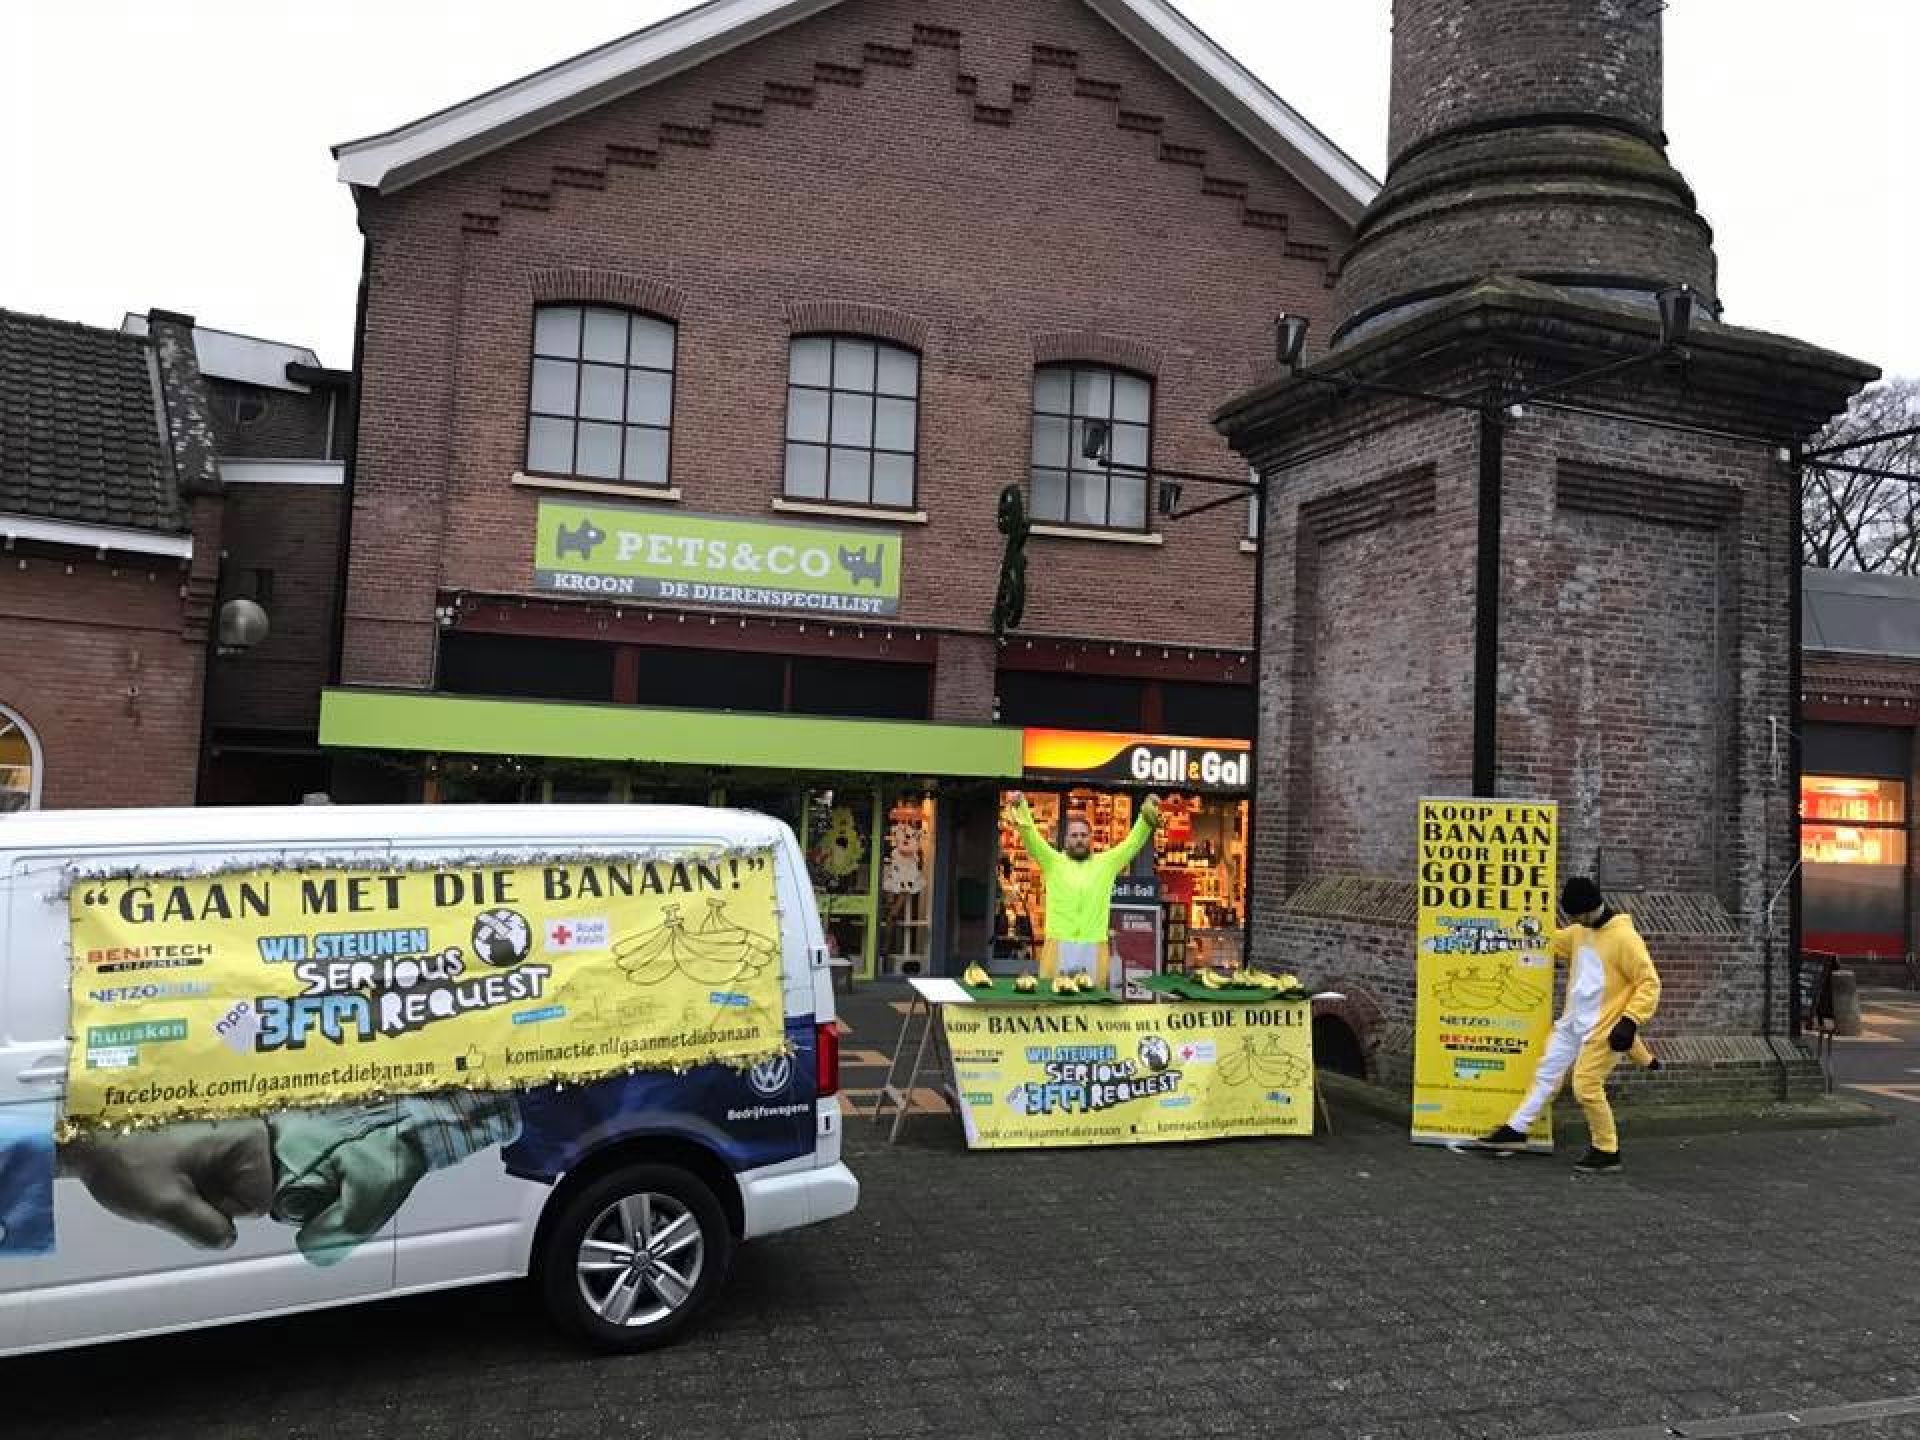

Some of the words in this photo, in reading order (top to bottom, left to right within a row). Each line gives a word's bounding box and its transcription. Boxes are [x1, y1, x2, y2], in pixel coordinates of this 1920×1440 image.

[616, 529, 832, 578] PETS&CO
[554, 573, 634, 593] KROON
[660, 582, 689, 598] DE
[693, 583, 883, 613] DIERENSPECIALIST
[1131, 747, 1187, 782] Gall
[1201, 750, 1248, 785] Gal
[1424, 805, 1493, 821] KOOP
[1505, 808, 1551, 823] EEN
[1423, 822, 1551, 846] BANAAN
[1424, 844, 1489, 861] VOOR
[1503, 847, 1548, 864] HET
[1422, 861, 1549, 888] GOEDE
[303, 875, 406, 915] MET
[433, 869, 519, 907] DIE
[1422, 886, 1549, 912] DOEL!!
[87, 943, 212, 964] BENITECH
[314, 928, 429, 960] STEUNEN
[297, 949, 464, 994] SERIOUS
[255, 994, 376, 1052] 3FM
[379, 965, 552, 1037] REQUEST
[987, 1015, 1088, 1034] BANANEN
[1167, 1009, 1237, 1029] GOEDE
[1245, 1009, 1304, 1027] DOEL!
[105, 1061, 434, 1107] facebook.com/gaanmetdiebanaan
